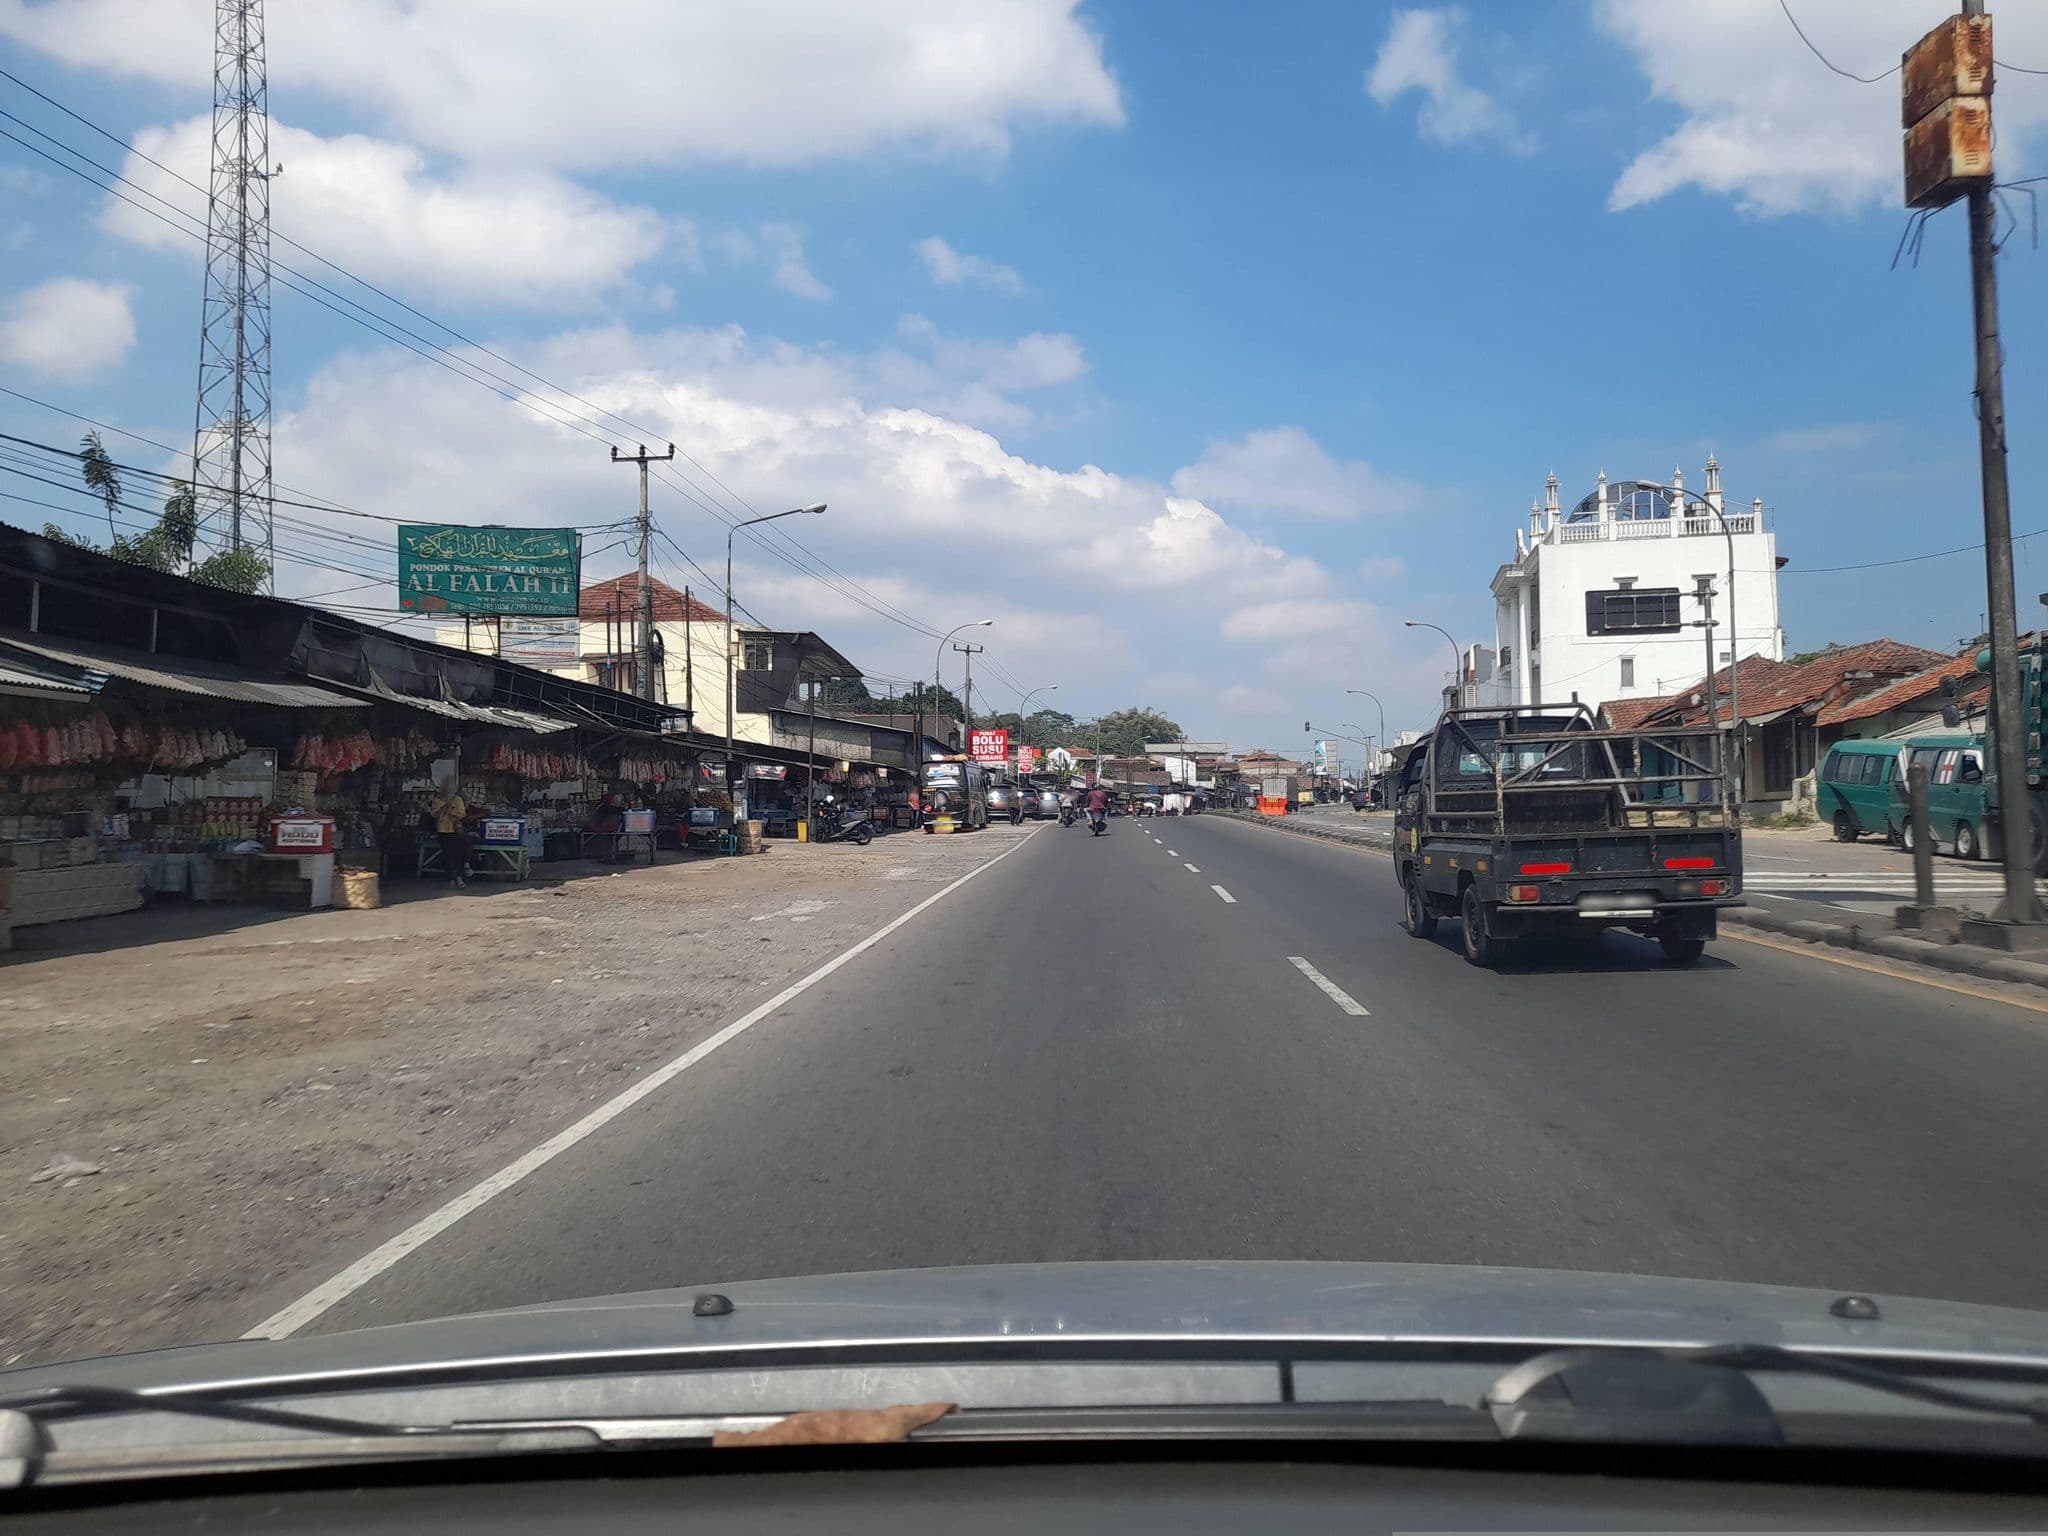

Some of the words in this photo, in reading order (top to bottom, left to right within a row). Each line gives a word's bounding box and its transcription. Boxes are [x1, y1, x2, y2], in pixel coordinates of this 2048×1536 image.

[409, 563, 451, 572] PONDOK
[514, 565, 526, 574] AL
[407, 573, 442, 592] AL
[449, 574, 541, 593] FALAH
[549, 576, 570, 594] II
[972, 736, 1004, 745] BOLU
[972, 745, 1004, 754] SUSU
